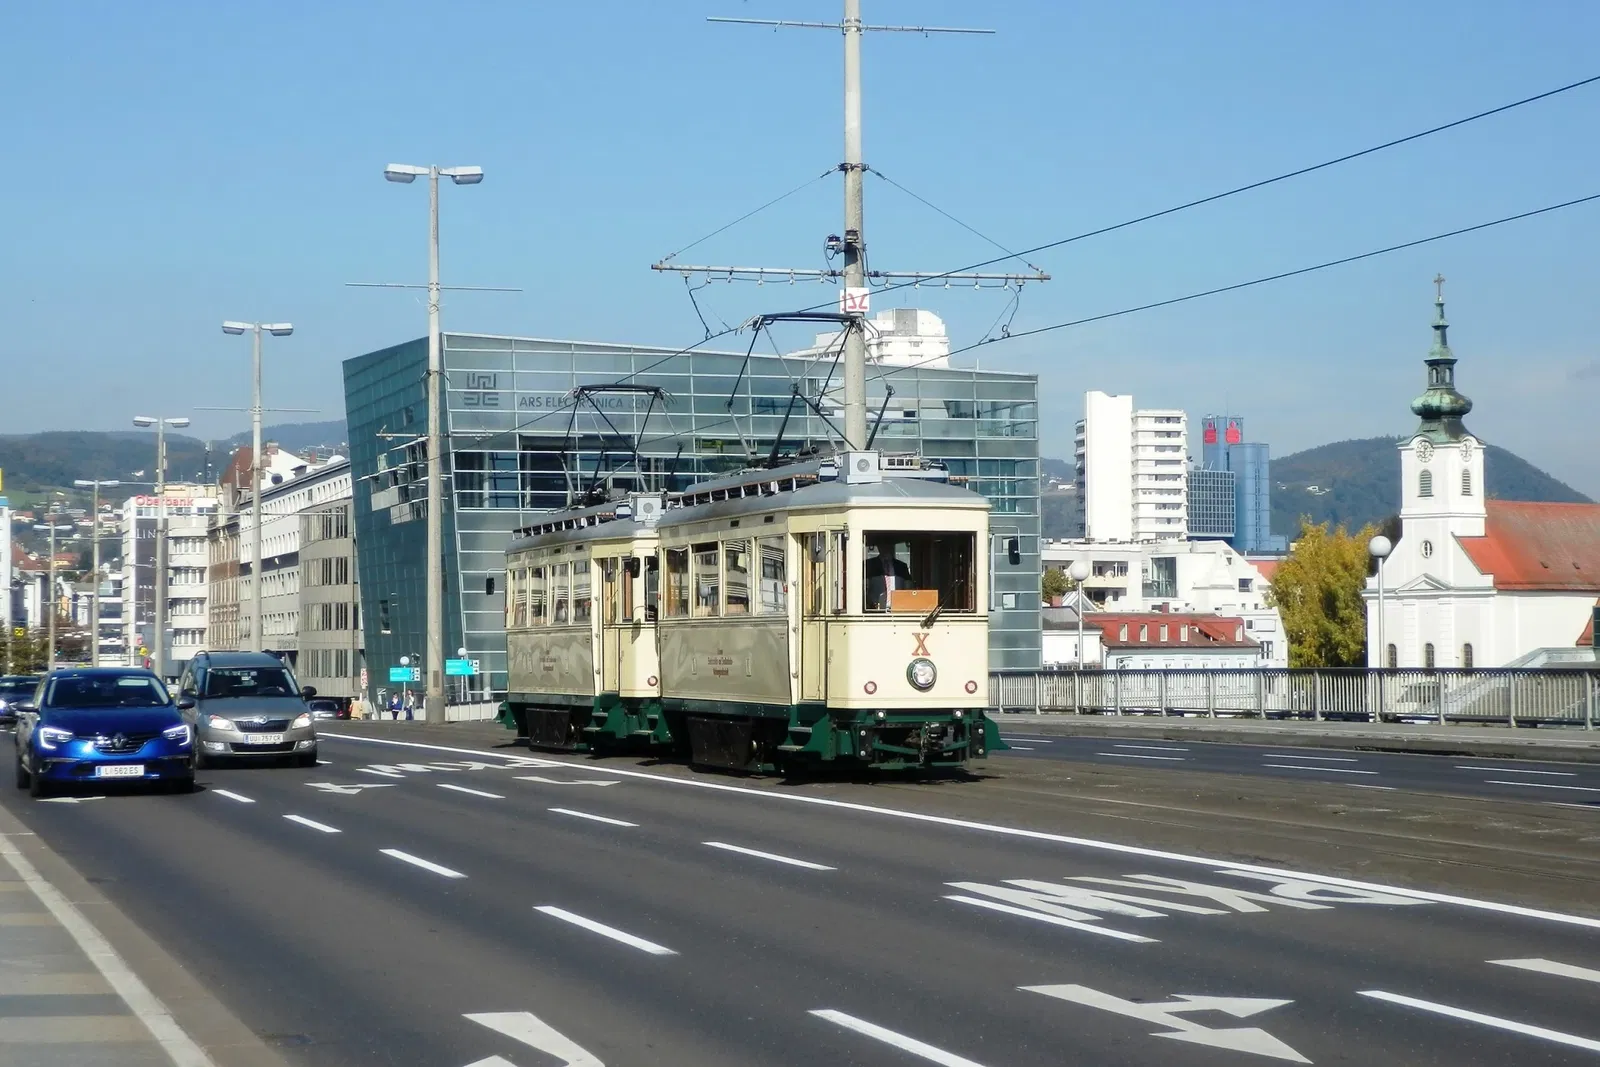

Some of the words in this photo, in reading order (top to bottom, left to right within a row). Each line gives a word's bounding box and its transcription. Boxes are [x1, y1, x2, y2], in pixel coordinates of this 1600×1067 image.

[520, 397, 542, 407] ARS
[546, 396, 623, 408] ELECRONICA
[911, 632, 931, 656] X
